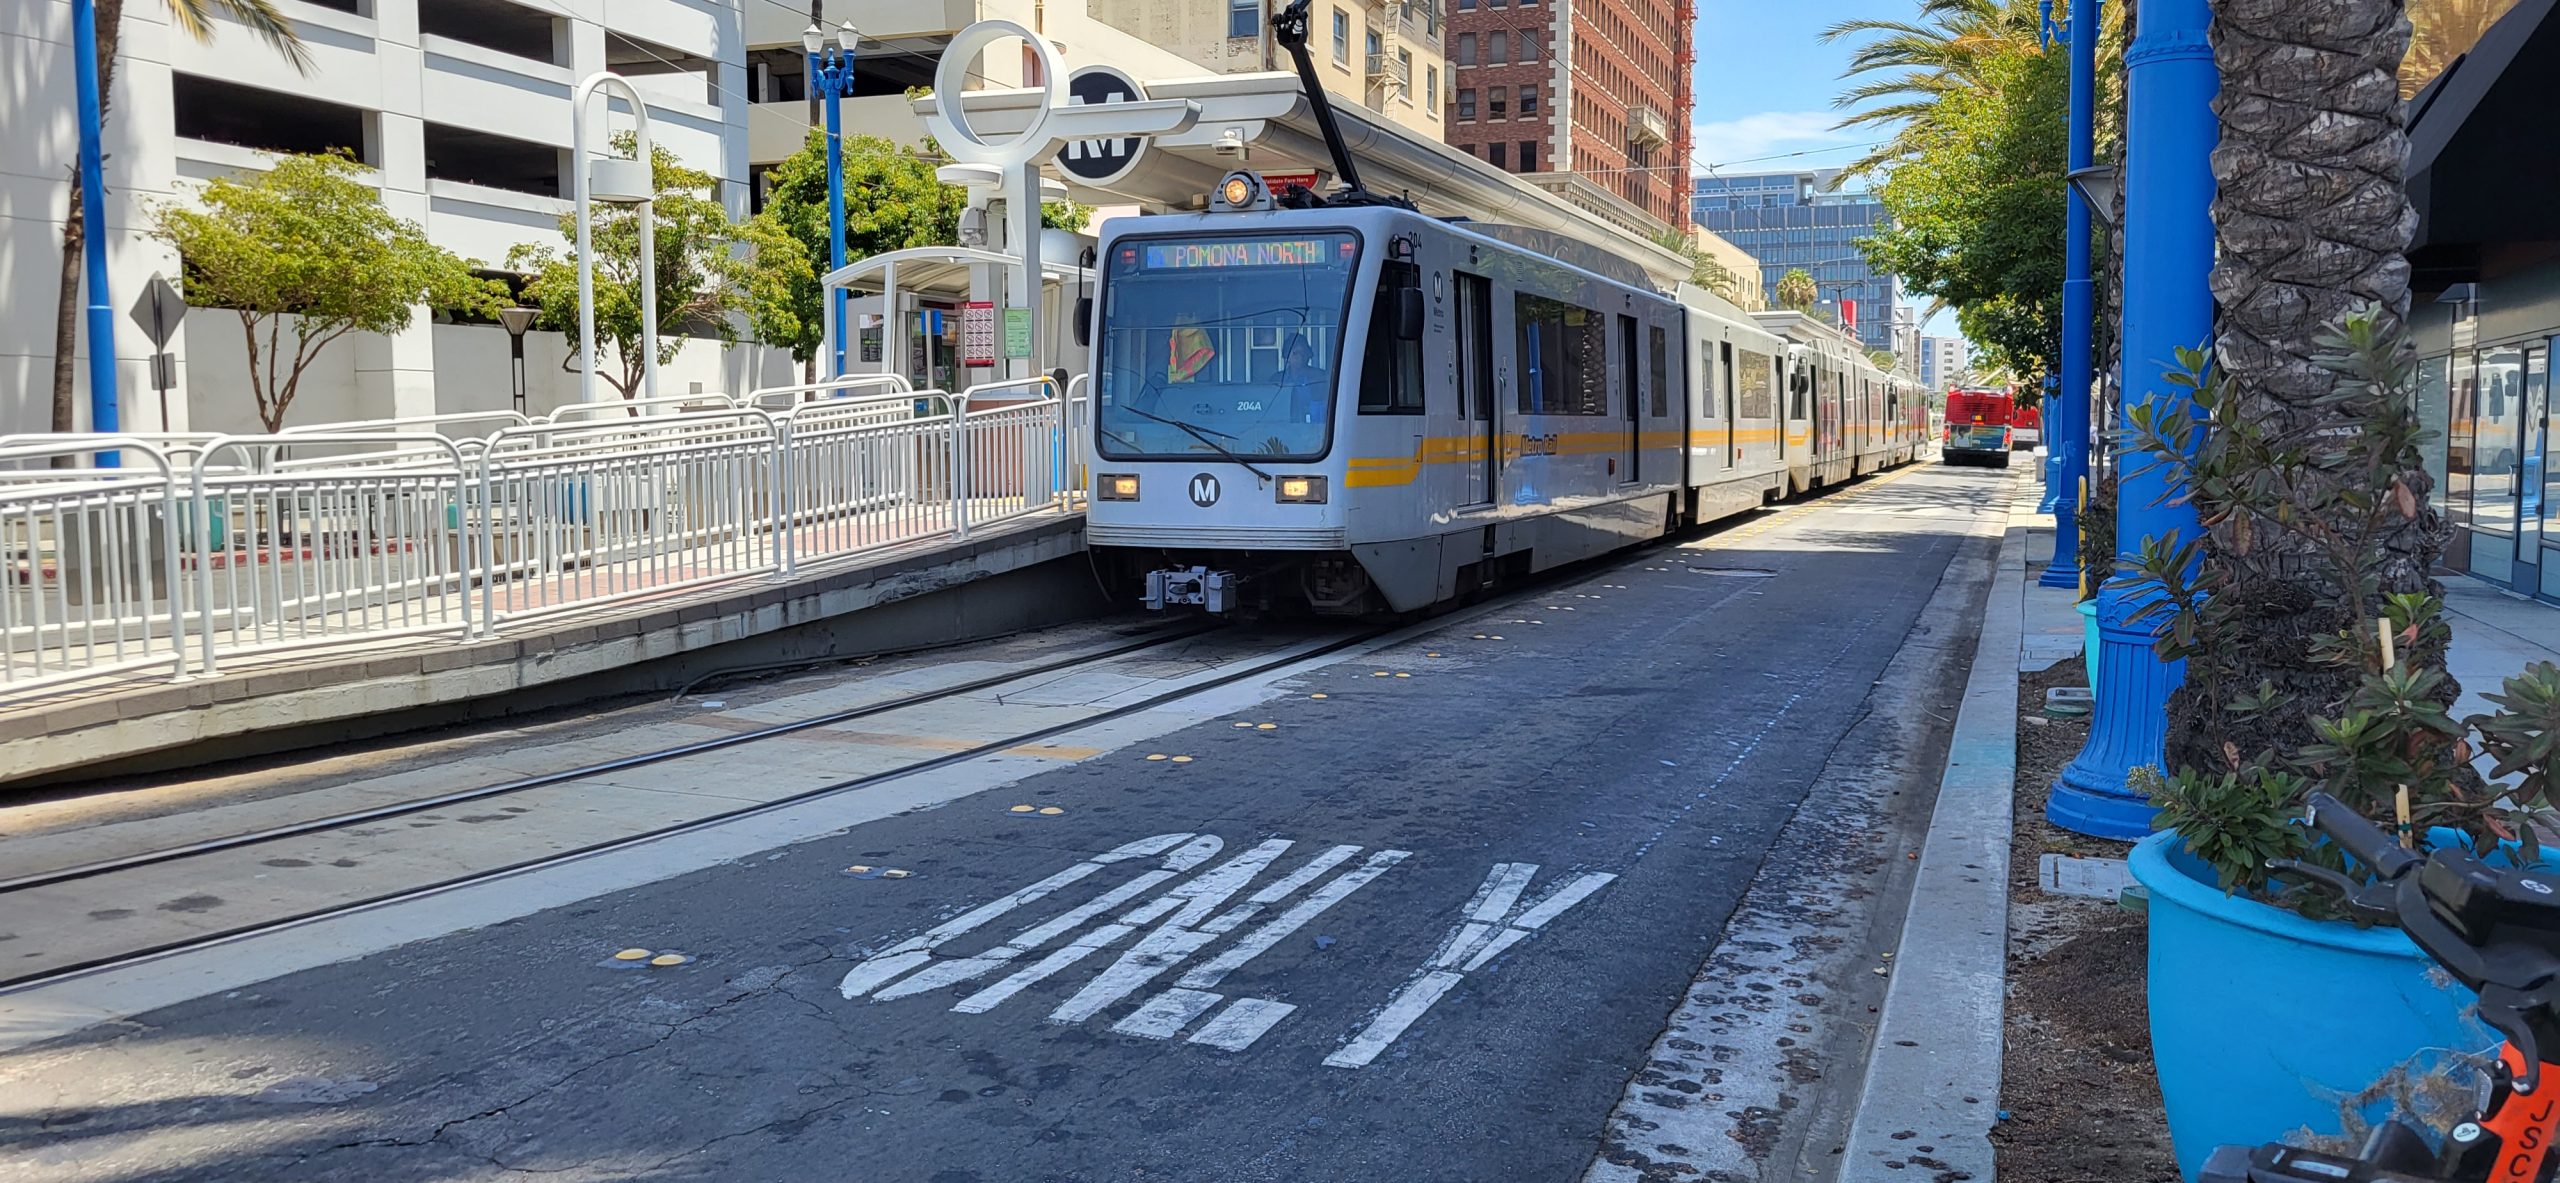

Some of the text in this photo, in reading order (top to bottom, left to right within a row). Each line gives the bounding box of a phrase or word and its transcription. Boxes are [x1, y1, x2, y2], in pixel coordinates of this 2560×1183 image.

[1175, 243, 1249, 268] POMONA
[1257, 240, 1317, 265] NORTH
[1237, 401, 1263, 411] 204A
[1520, 433, 1558, 457] Metro Rail
[1194, 479, 1216, 502] M
[839, 831, 1620, 1069] ONLY
[2508, 1099, 2555, 1183] JSC
